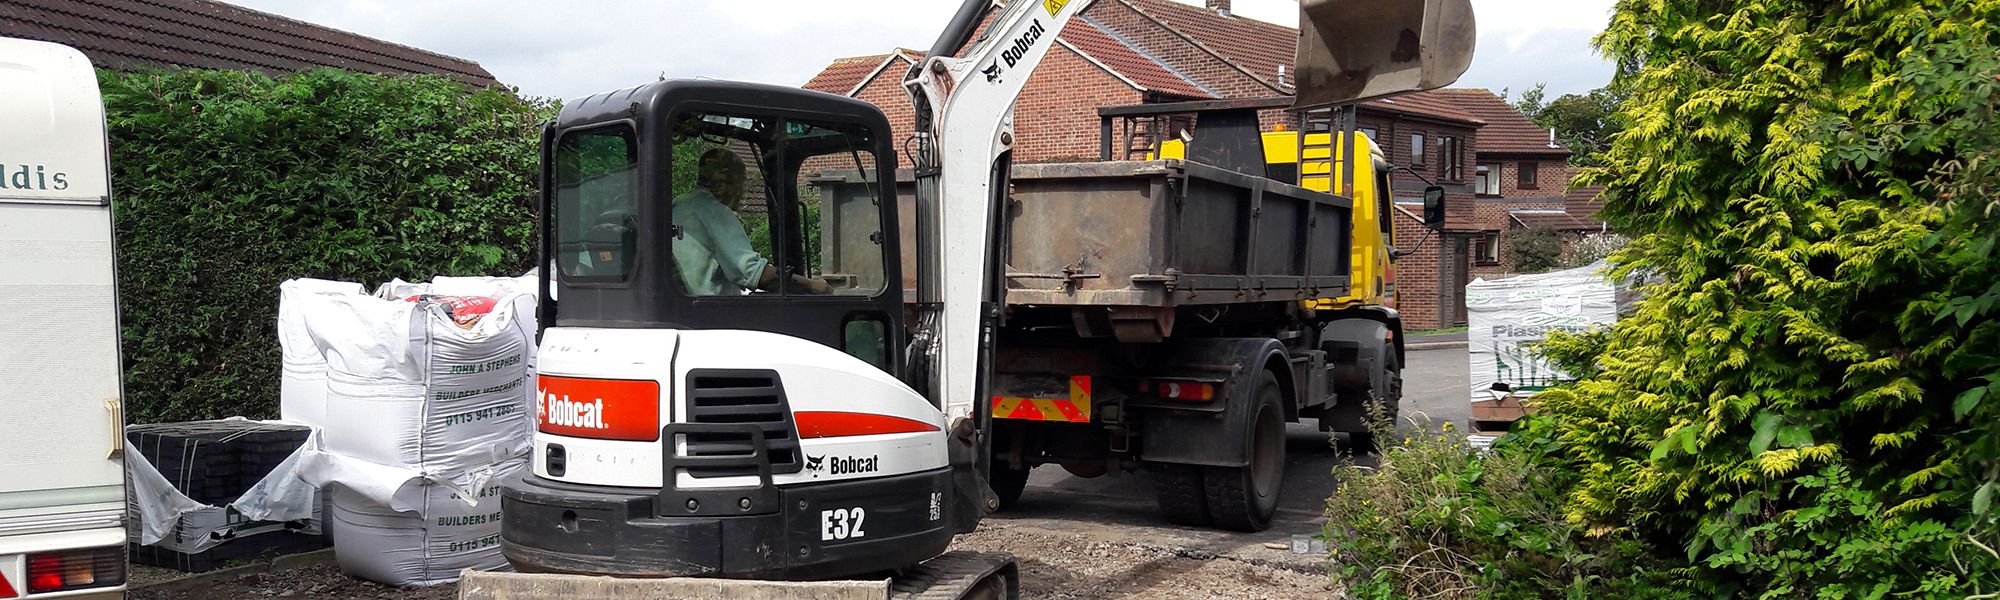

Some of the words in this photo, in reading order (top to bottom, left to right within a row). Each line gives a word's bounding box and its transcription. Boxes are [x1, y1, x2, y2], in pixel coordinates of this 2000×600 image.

[1001, 18, 1045, 69] Bobcat
[450, 364, 475, 374] JOHN
[478, 363, 484, 373] A
[486, 354, 521, 372] STEPHENS
[446, 412, 473, 426] 0115
[476, 408, 494, 421] 941
[830, 454, 879, 475] Bobcat
[438, 515, 486, 526] BUILDERS
[821, 507, 865, 541] E32
[450, 541, 478, 552] 0115
